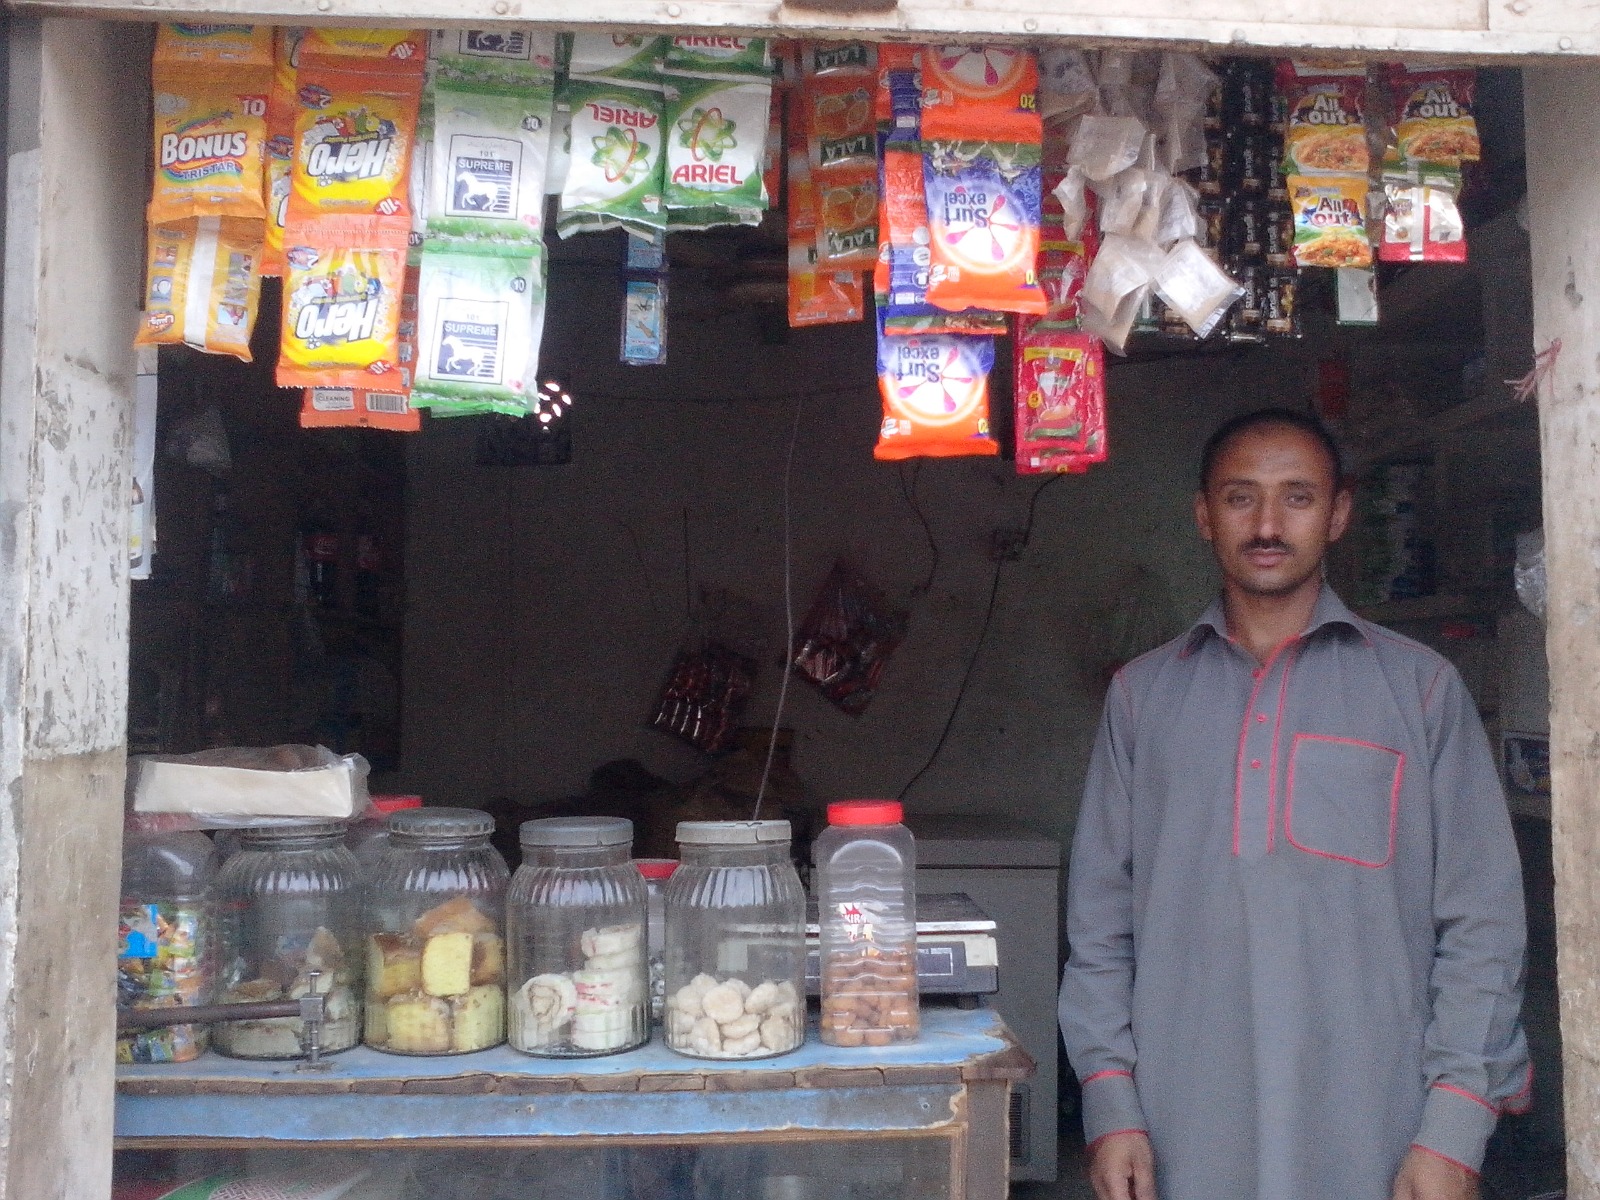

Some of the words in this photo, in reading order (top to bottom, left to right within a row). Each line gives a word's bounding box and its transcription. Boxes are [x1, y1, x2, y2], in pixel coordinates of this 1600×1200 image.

[672, 36, 746, 50] ARIEL
[817, 44, 860, 69] LALA
[1020, 93, 1035, 108] 20
[1313, 94, 1338, 110] All
[1424, 87, 1451, 104] All
[241, 99, 266, 116] 10
[1420, 102, 1459, 118] out
[525, 117, 539, 129] 10
[585, 103, 659, 129] ARIEL
[1308, 109, 1346, 125] out
[161, 131, 247, 167] BONUS
[825, 135, 868, 161] LALA
[307, 137, 390, 179] Hero
[458, 157, 511, 173] SUPREME
[182, 161, 236, 180] TRISTAR
[671, 164, 743, 185] ARIEL
[943, 192, 987, 206] excel
[1317, 197, 1342, 212] All
[943, 207, 988, 228] Surf
[1311, 212, 1350, 226] out
[830, 228, 875, 253] LALA
[511, 278, 525, 292] 10
[295, 297, 378, 342] Hero
[443, 322, 498, 337] SUPREME
[896, 346, 940, 360] excel
[895, 362, 940, 384] Surf
